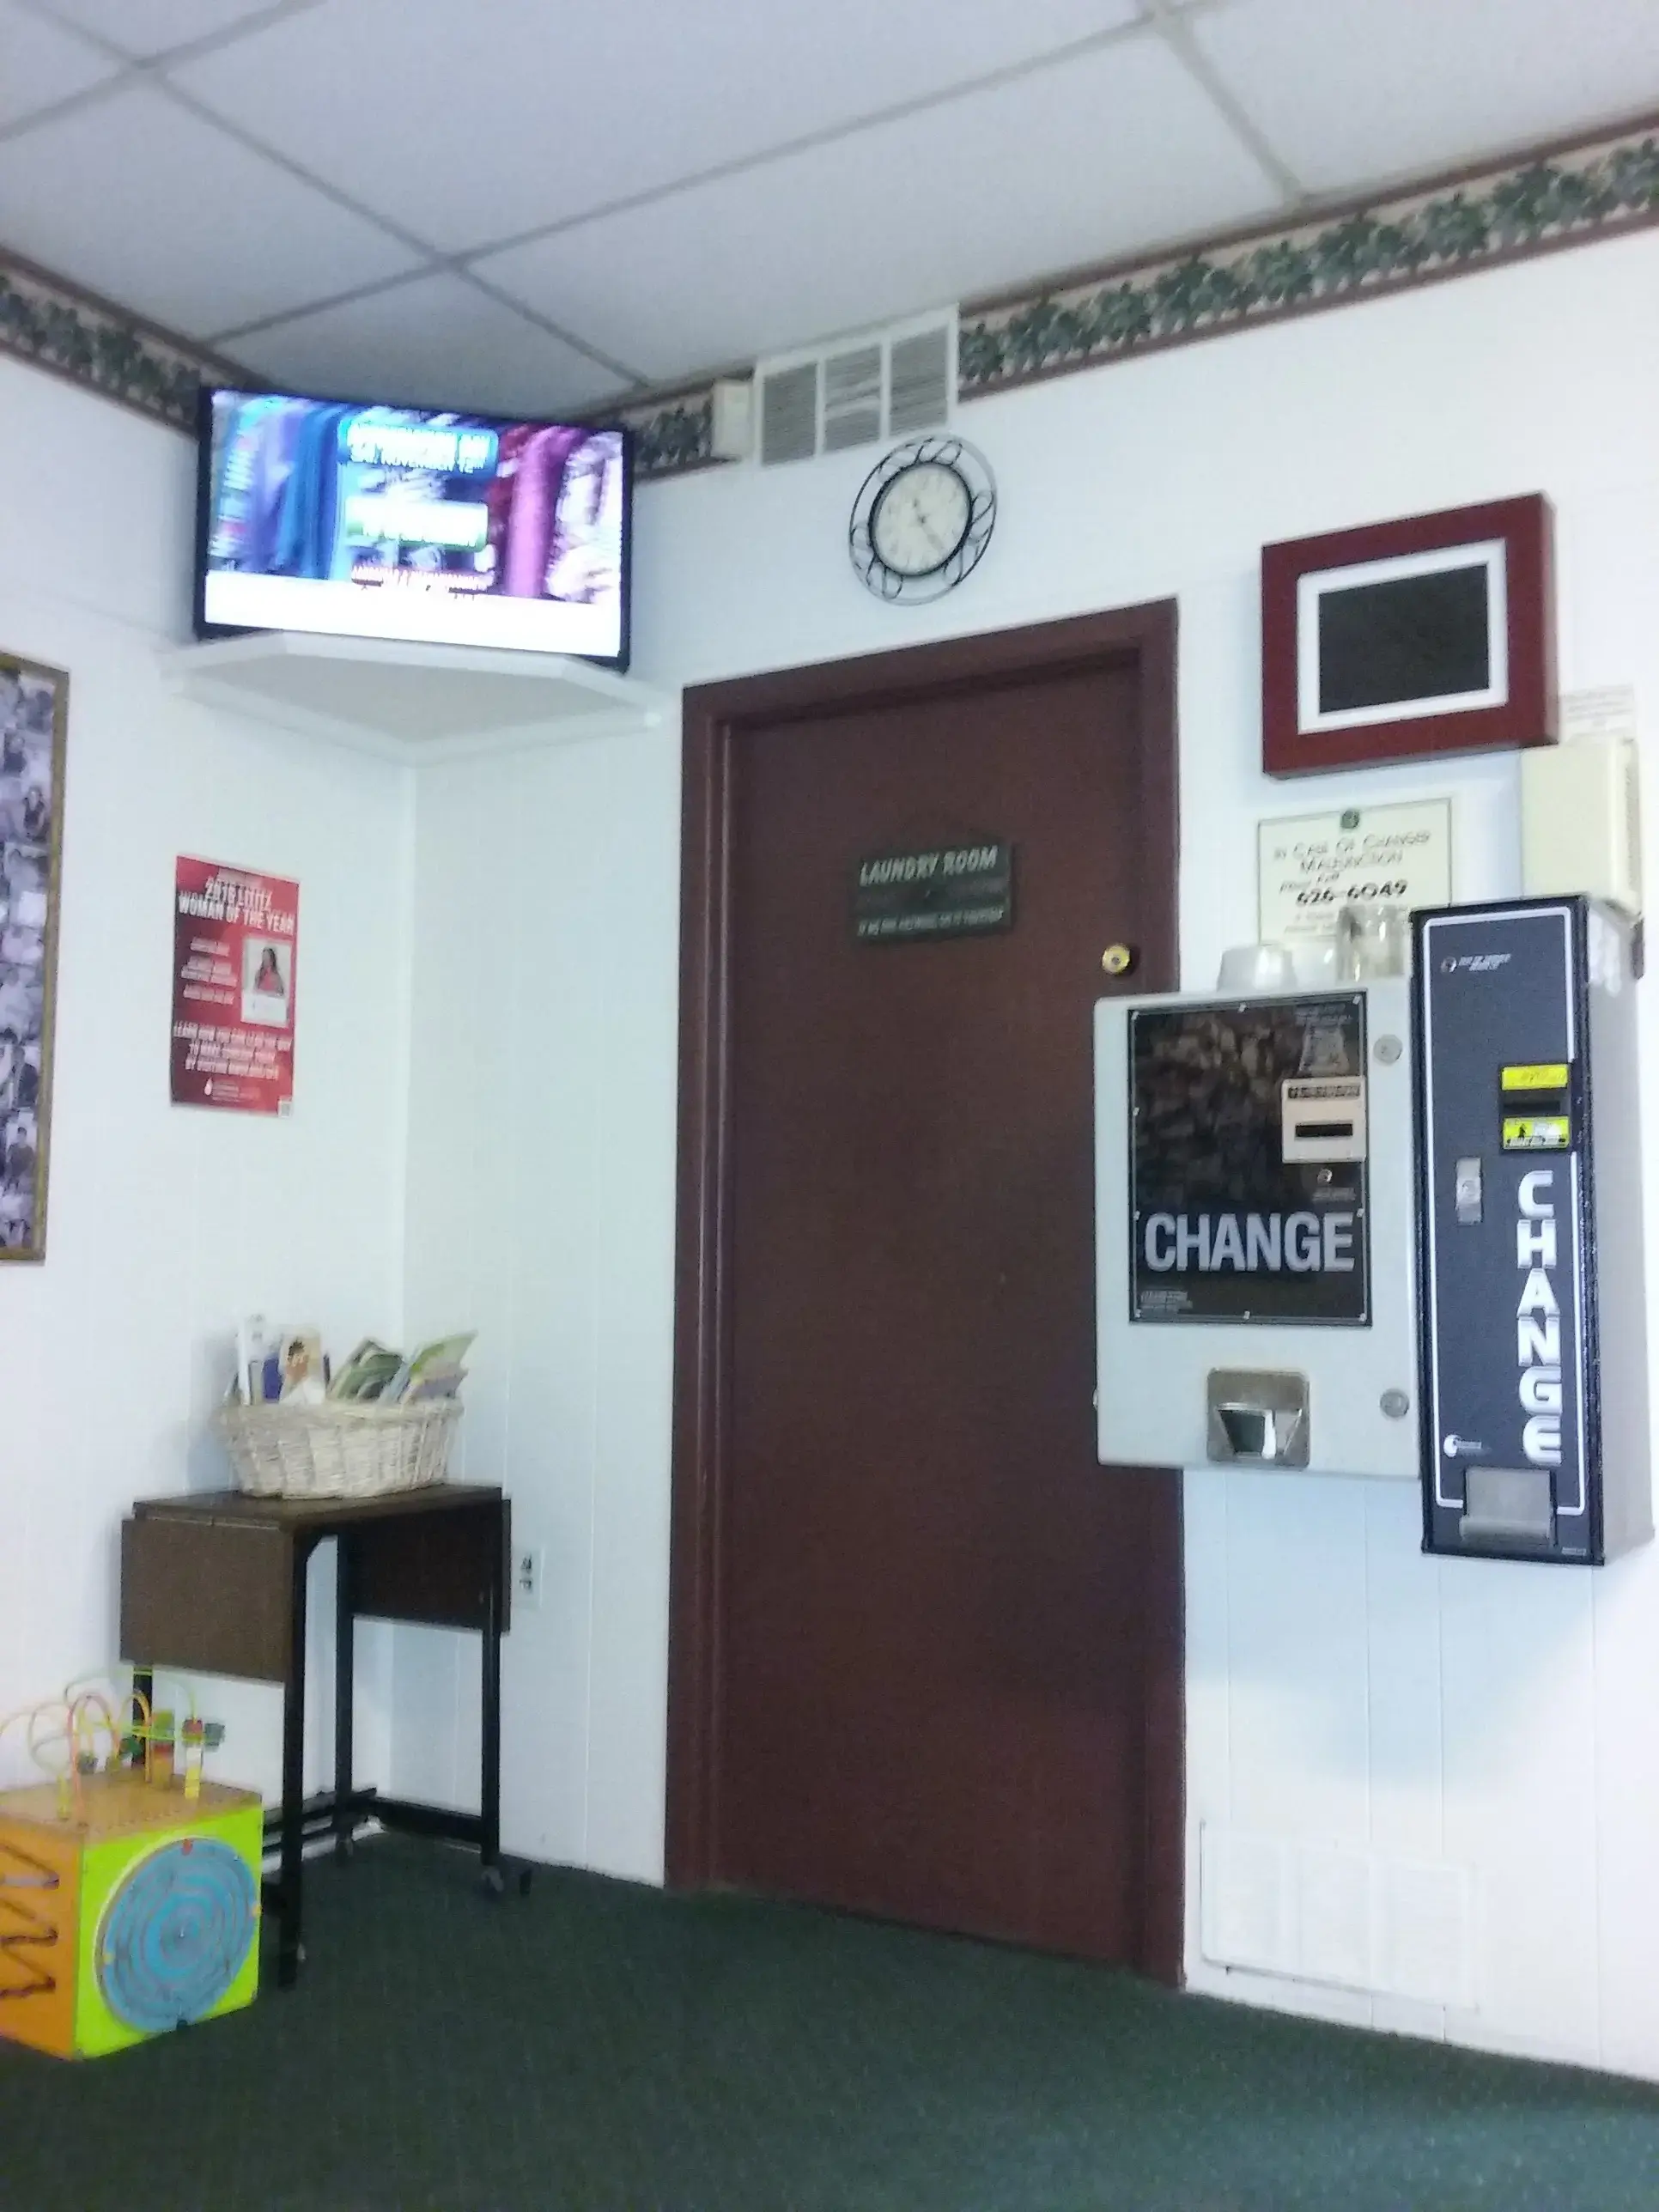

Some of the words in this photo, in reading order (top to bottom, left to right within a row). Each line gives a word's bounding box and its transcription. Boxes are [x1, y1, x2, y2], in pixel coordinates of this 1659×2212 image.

[859, 852, 940, 887] LAUNDRY
[943, 845, 999, 876] ROOM
[178, 892, 224, 921] WOMAN
[225, 902, 241, 924] OF
[242, 907, 262, 929] THE
[265, 911, 295, 935] YEAR
[1144, 1211, 1356, 1273] CHANGE
[1516, 1169, 1563, 1467] CHANGE
